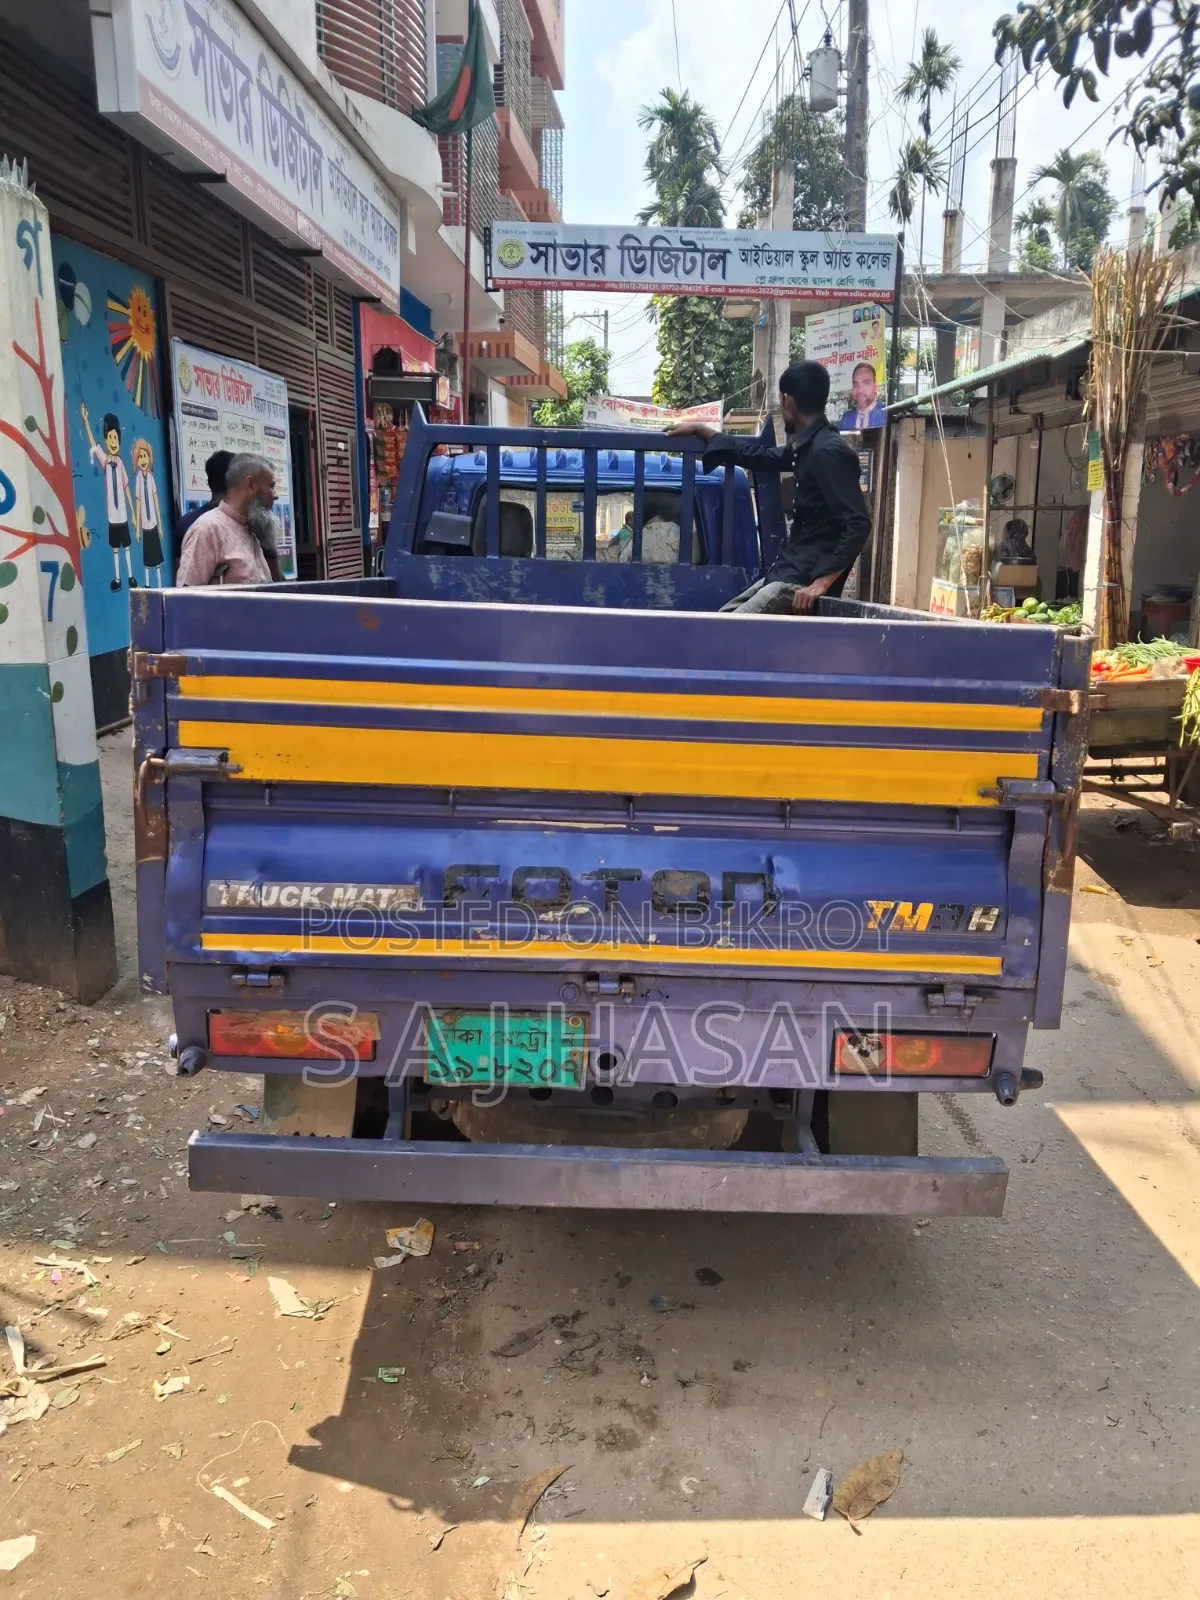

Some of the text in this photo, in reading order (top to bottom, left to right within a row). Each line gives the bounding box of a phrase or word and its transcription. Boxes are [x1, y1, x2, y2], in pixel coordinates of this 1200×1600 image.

[256, 51, 325, 218] ডিজিটাল
[527, 238, 611, 277] সাভার
[616, 234, 732, 281] ডিজিটাল
[738, 242, 795, 269] আইডিয়াল
[798, 249, 820, 273] স্কুল
[856, 251, 893, 271] কলেজ
[705, 285, 726, 293] E-mail:
[788, 276, 808, 285] থেকে
[856, 344, 880, 362] শহীদ
[193, 364, 220, 400] সাভার
[221, 363, 253, 409] ডিজিটাল
[687, 405, 719, 417] কলেজ
[40, 561, 59, 622] 7
[216, 884, 325, 908] TRUCK
